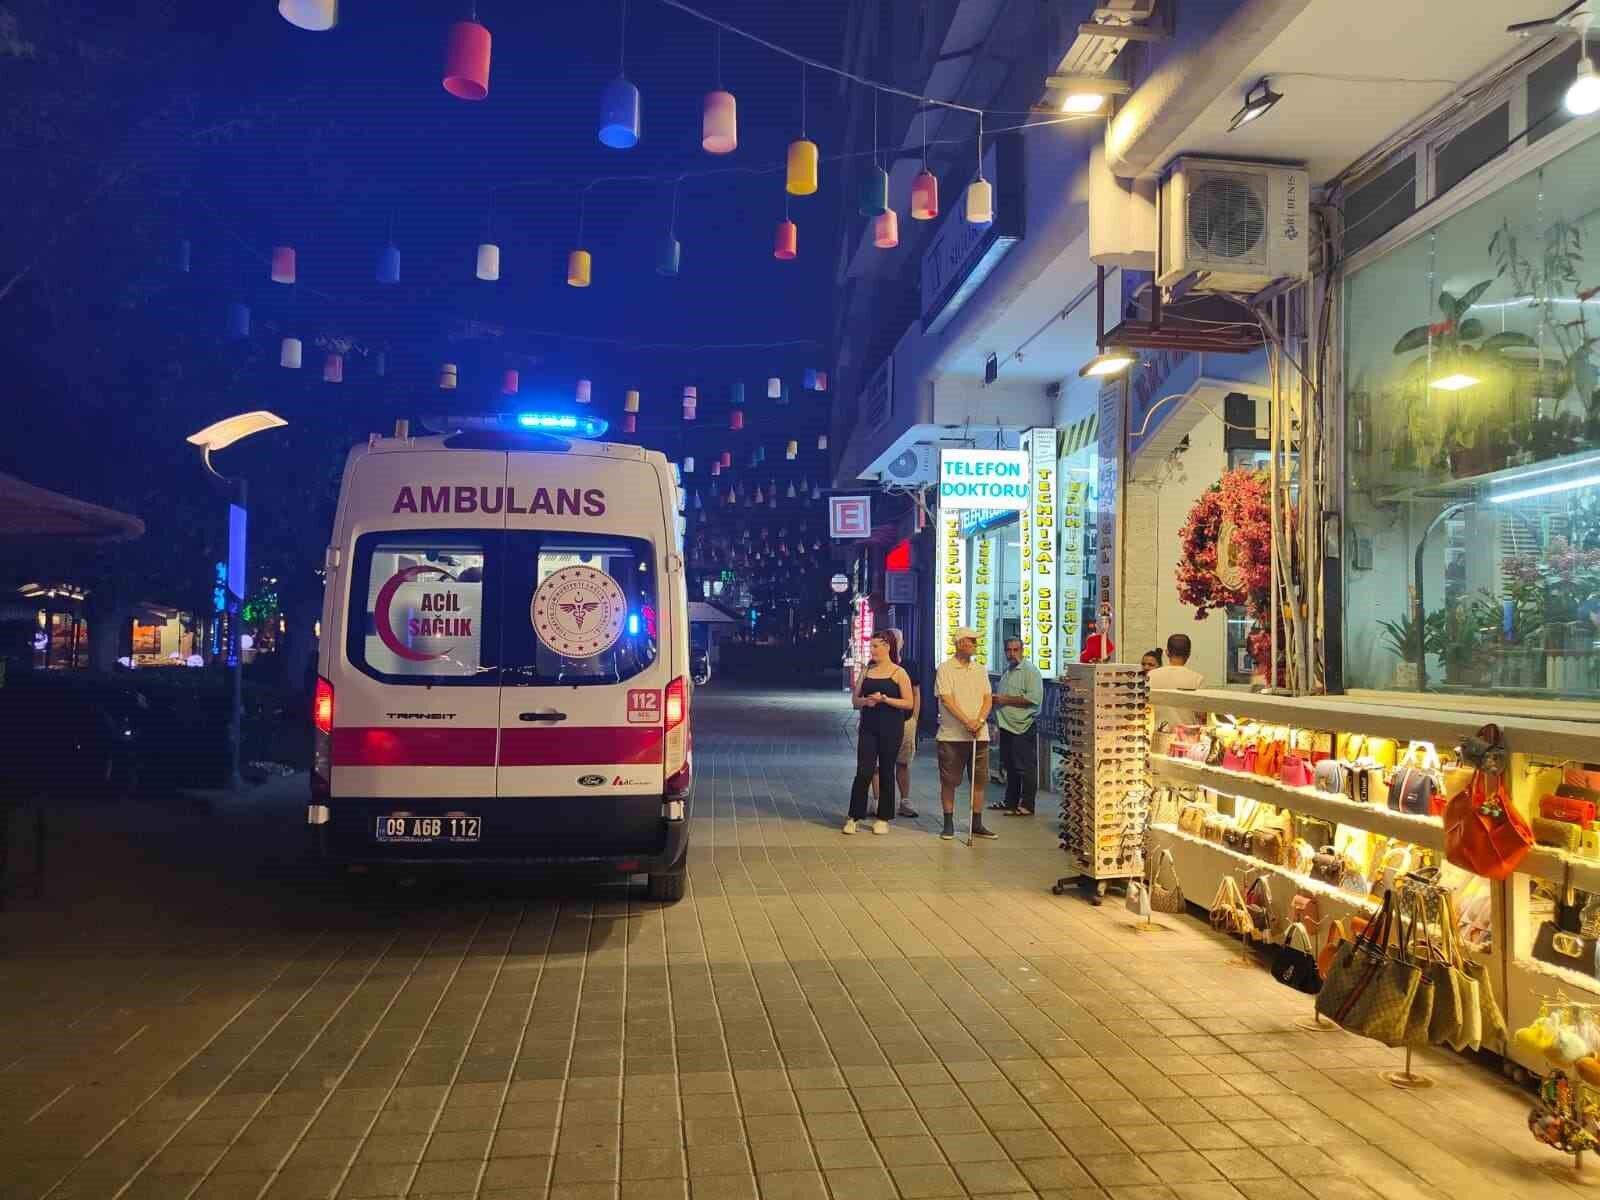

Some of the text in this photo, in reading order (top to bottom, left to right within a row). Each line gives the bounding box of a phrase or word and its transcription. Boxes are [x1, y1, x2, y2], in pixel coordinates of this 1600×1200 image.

[943, 461, 1020, 476] TELEFON
[391, 485, 606, 517] AMBULANS
[941, 482, 1029, 498] DOKTORU
[840, 505, 861, 529] E
[1037, 468, 1053, 671] TECHNICAL SERVICE
[420, 590, 460, 613] ACİL
[408, 614, 472, 638] SAĞLIK
[632, 693, 657, 709] 112
[387, 818, 405, 836] 09
[413, 819, 441, 837] AGB
[450, 819, 478, 837] 112
